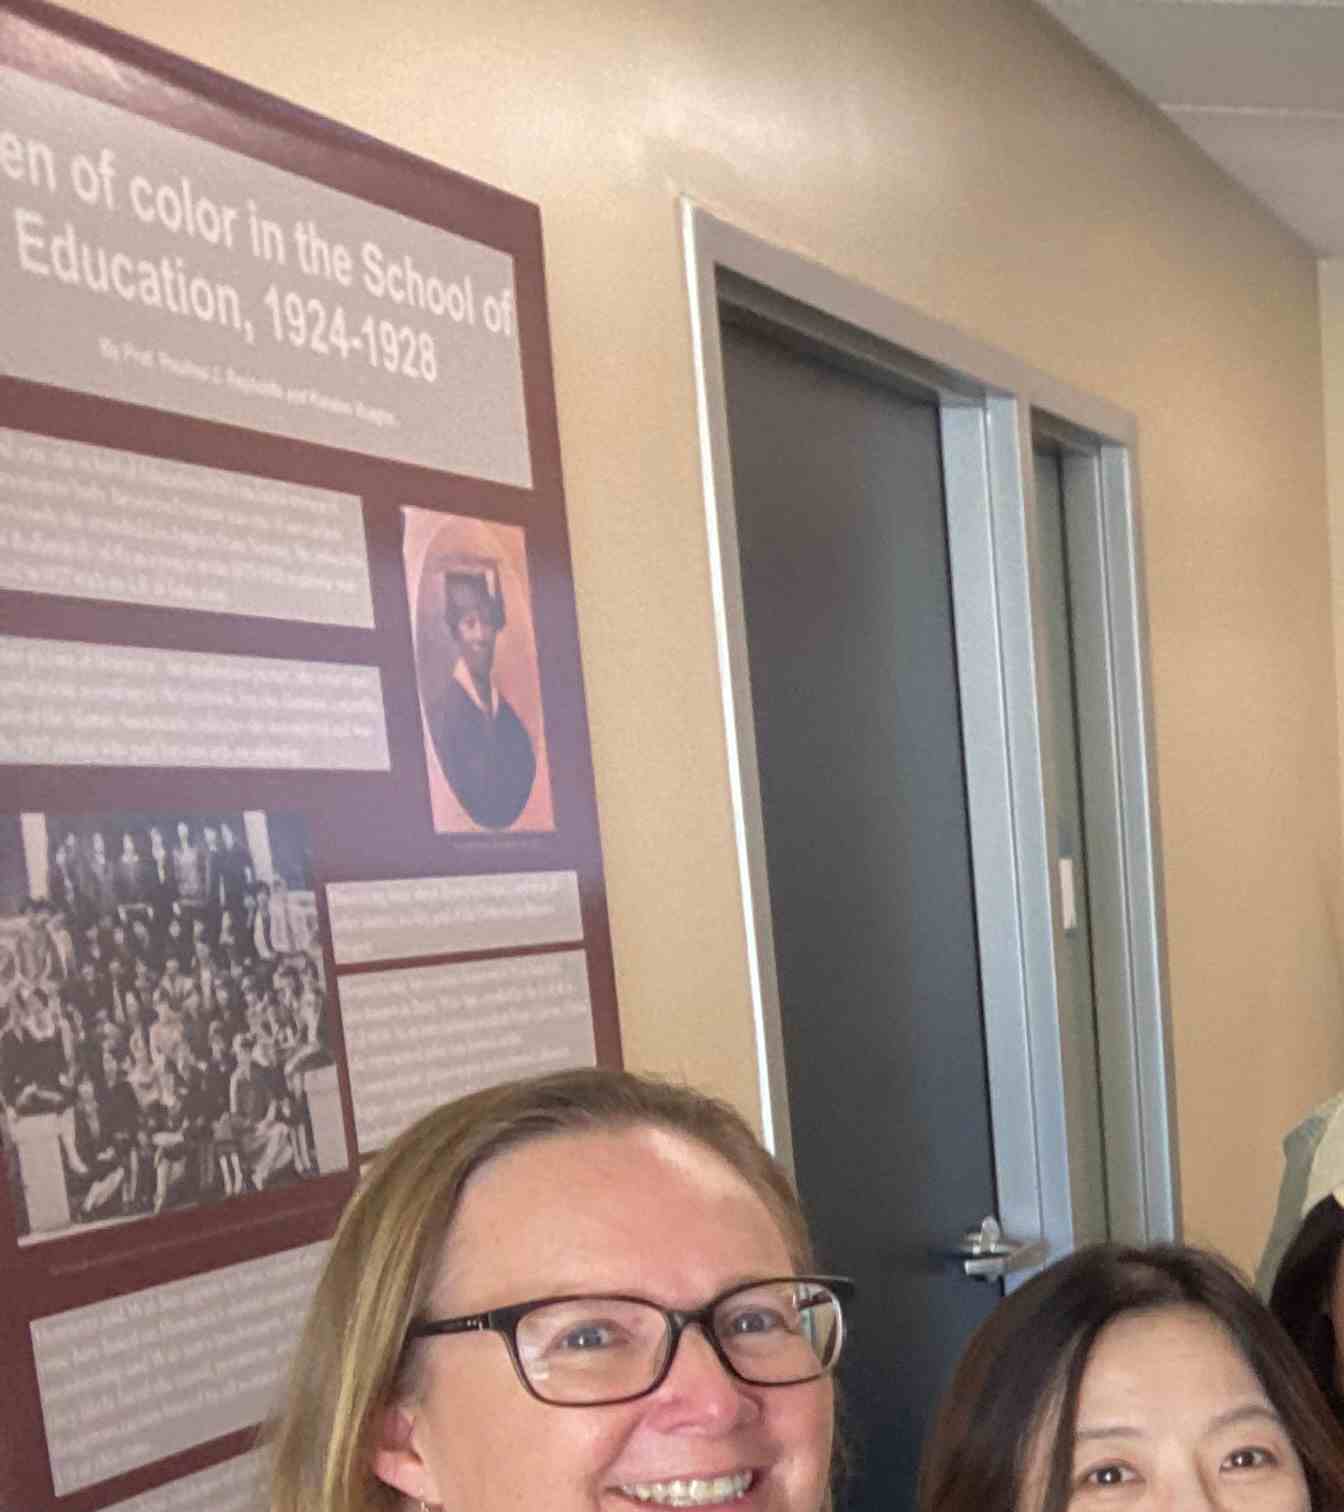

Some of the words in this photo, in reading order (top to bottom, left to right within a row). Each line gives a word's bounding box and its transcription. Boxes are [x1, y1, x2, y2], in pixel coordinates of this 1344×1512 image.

[14, 206, 255, 346] Education,
[264, 283, 438, 383] 1924-1928
[71, 147, 116, 211] of
[129, 175, 238, 250] color
[247, 197, 286, 266] in
[293, 219, 353, 288] the
[361, 240, 476, 326] School
[482, 288, 514, 337] of
